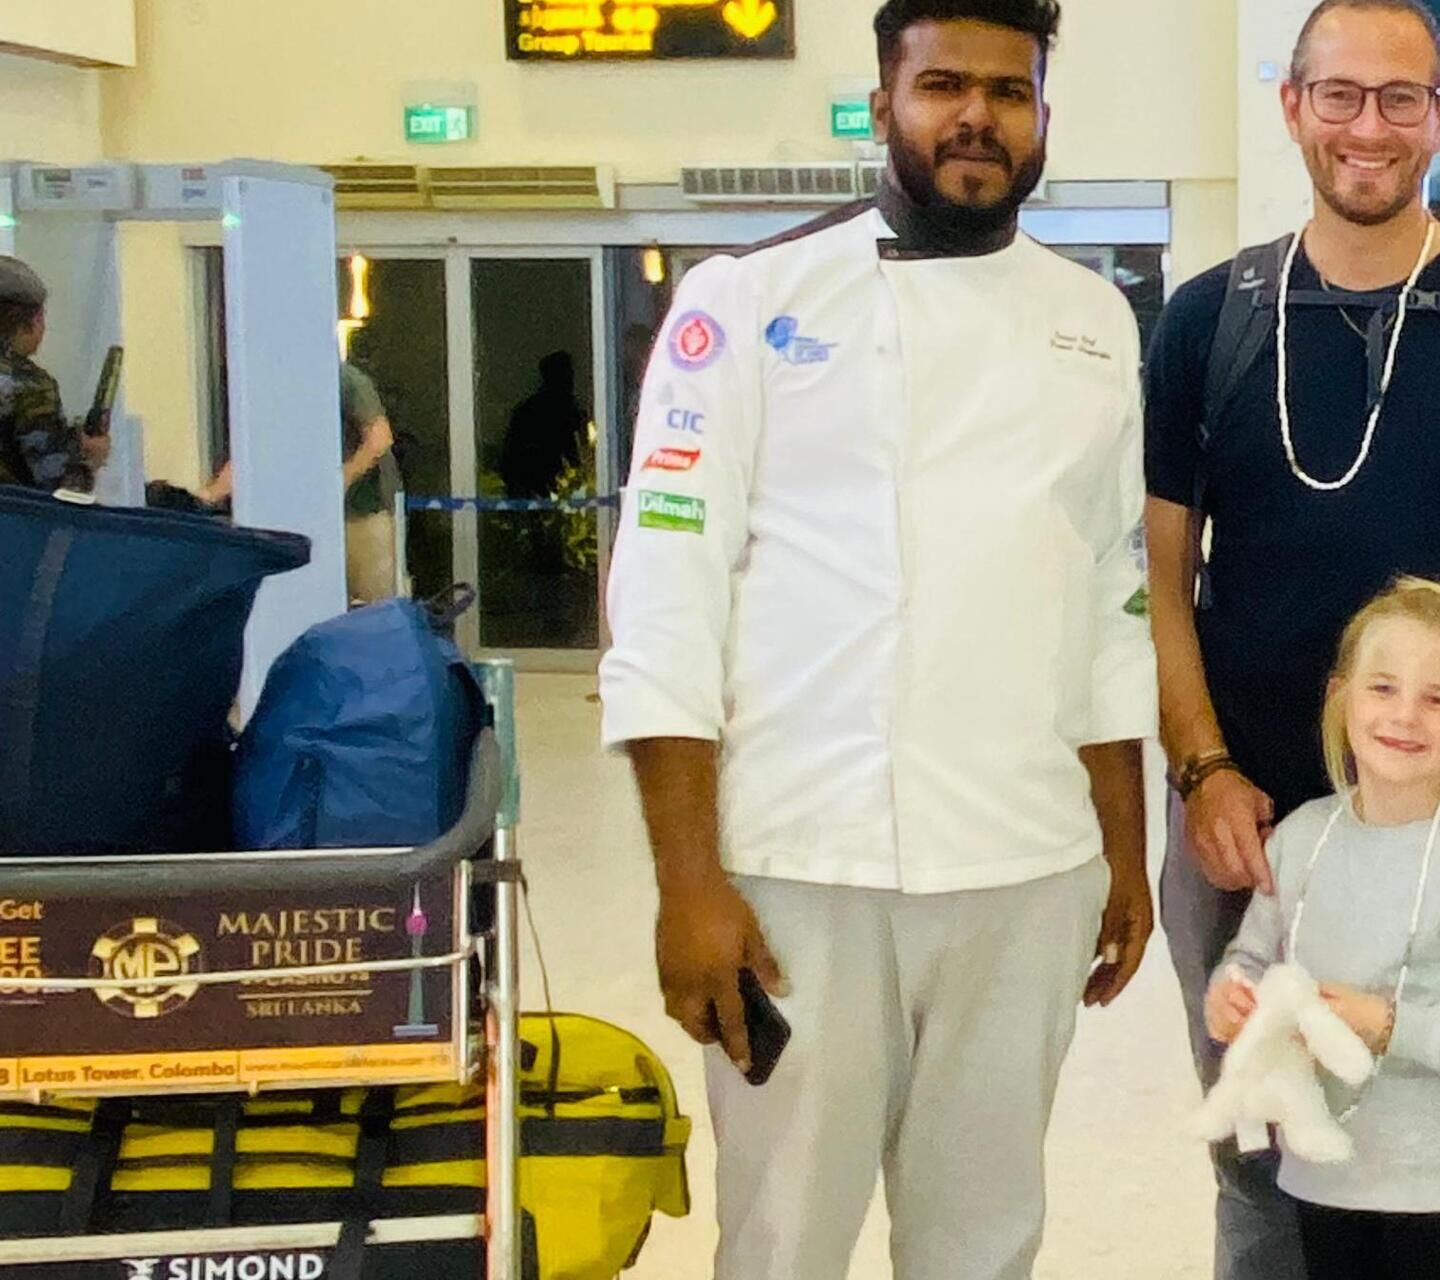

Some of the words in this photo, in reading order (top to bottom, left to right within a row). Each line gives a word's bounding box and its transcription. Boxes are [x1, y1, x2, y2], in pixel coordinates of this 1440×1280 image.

[410, 115, 441, 133] EXIT
[667, 407, 705, 434] CIC
[640, 491, 704, 520] Dilmah
[217, 907, 396, 937] MAJESTIC
[252, 937, 363, 966] PRIDE
[246, 1001, 282, 1017] SRI
[286, 999, 363, 1016] LANKA
[22, 1068, 76, 1083] Lotus
[151, 1061, 236, 1079] Colombo
